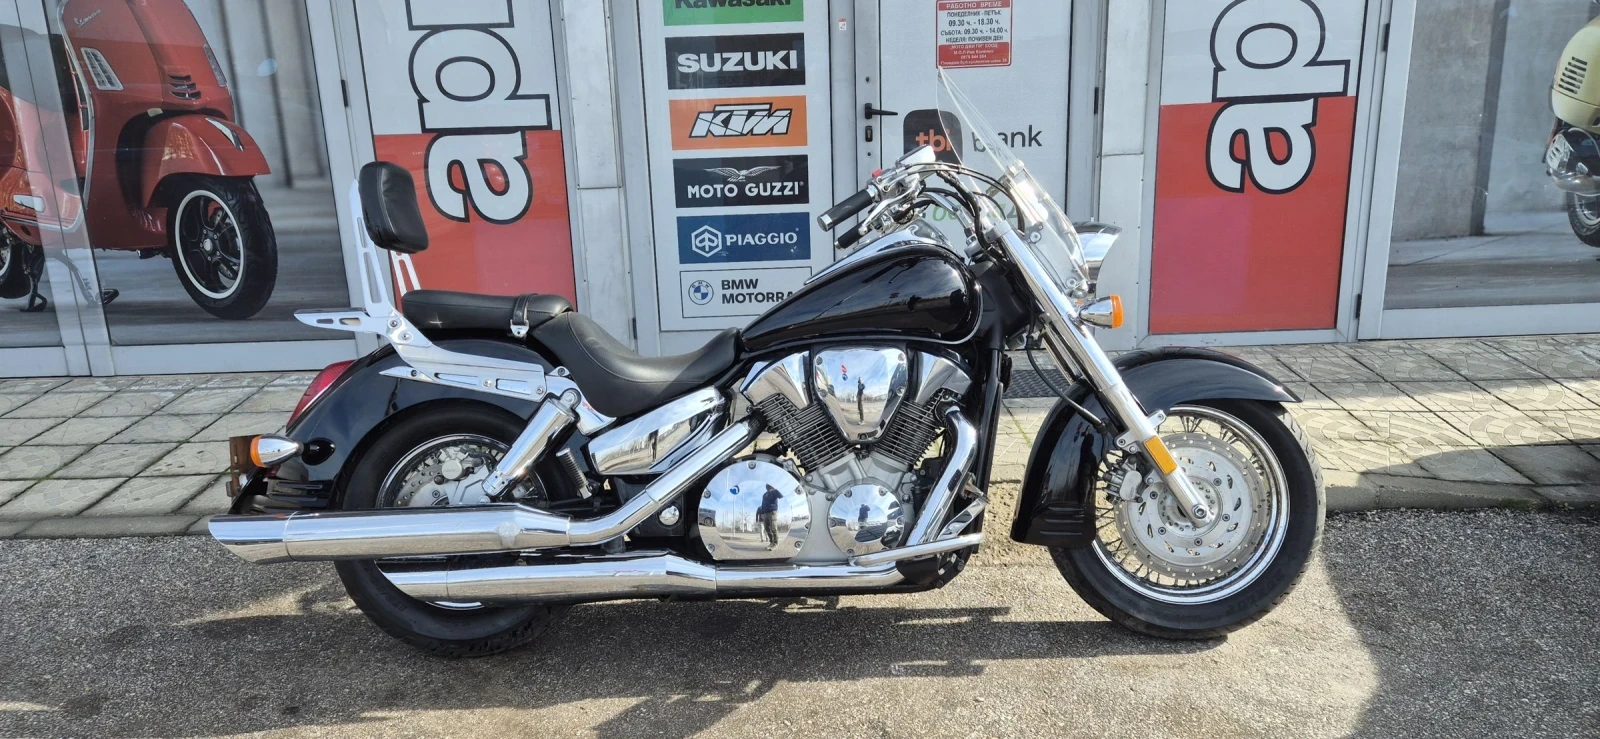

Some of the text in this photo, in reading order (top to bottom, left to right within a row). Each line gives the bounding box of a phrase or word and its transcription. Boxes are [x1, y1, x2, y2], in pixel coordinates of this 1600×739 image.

[677, 50, 798, 73] SUZUKI
[689, 102, 792, 138] KTM
[916, 129, 952, 152] tbi
[687, 181, 800, 198] MOTO GUZZI
[725, 232, 798, 246] PIAGGIO
[721, 278, 759, 290] BMW
